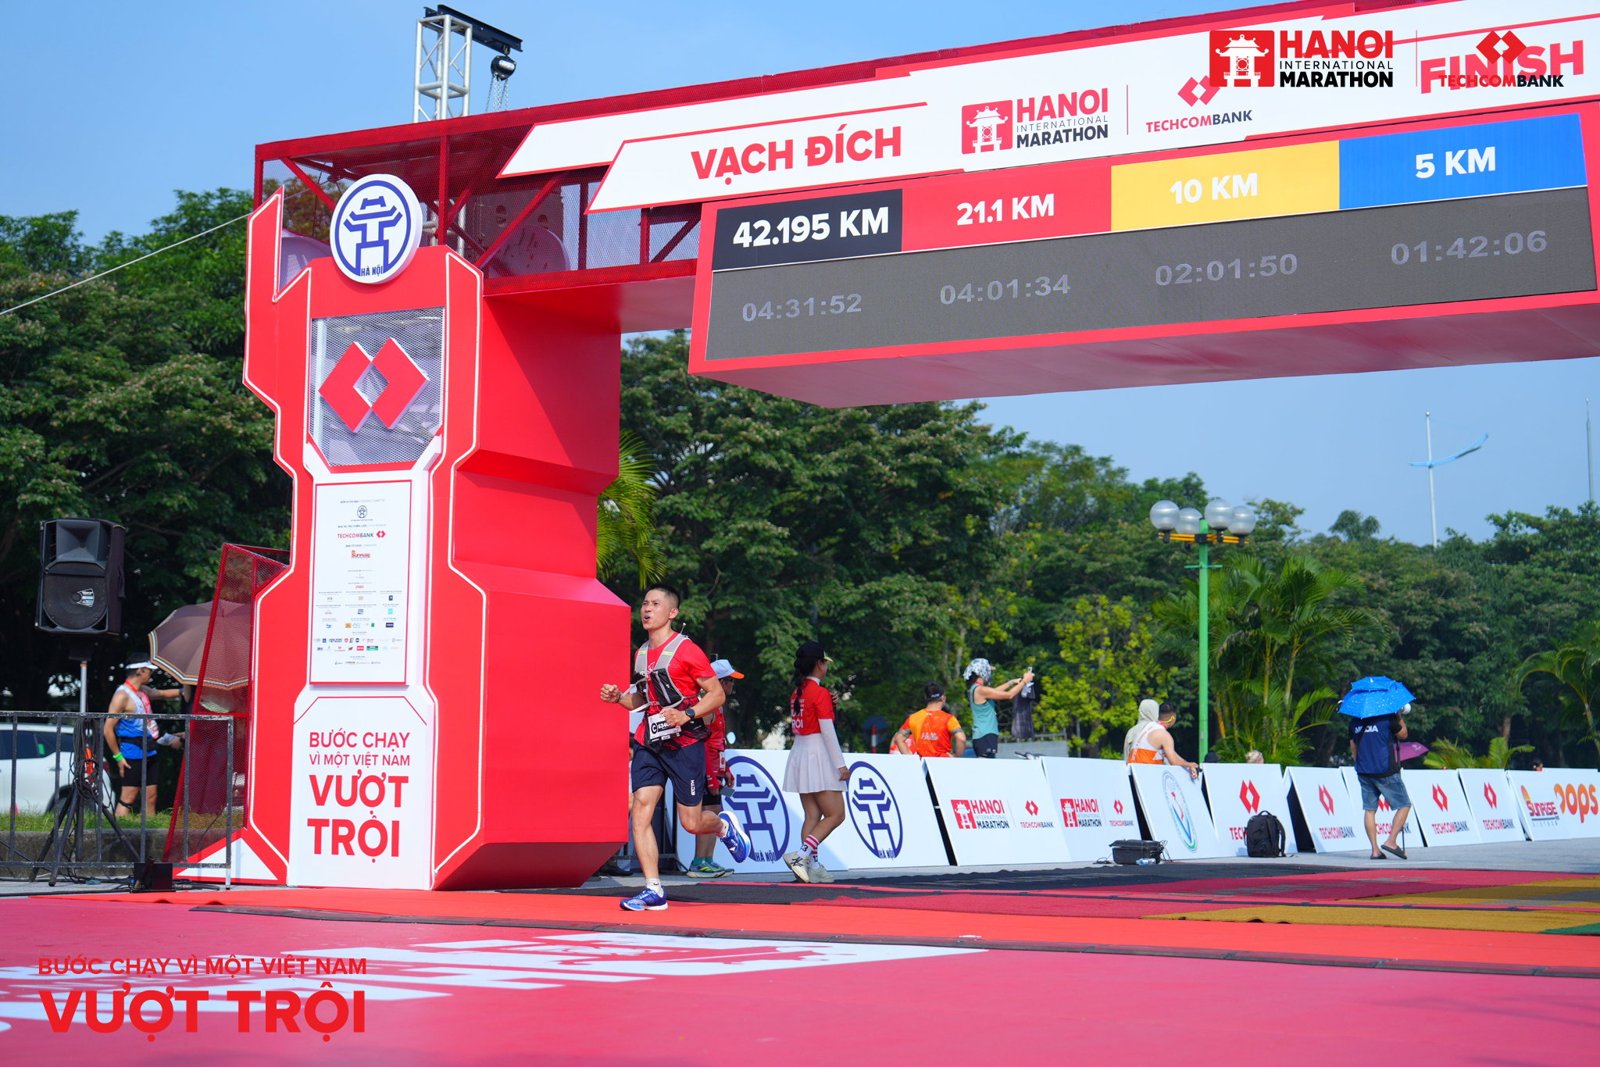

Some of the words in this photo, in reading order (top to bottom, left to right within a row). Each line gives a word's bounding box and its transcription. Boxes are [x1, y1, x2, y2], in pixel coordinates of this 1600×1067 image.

[1421, 40, 1585, 94] FINISH
[1016, 87, 1109, 122] HANOI
[1016, 114, 1109, 133] INTERNATIONAL
[1145, 109, 1253, 134] TECHCOMBANK
[1016, 124, 1109, 149] MARATHON
[690, 137, 794, 185] VẠCH
[804, 123, 901, 167] ĐÍCH
[1414, 153, 1436, 179] 5
[1445, 146, 1496, 176] KM
[1169, 177, 1203, 205] 10
[1210, 172, 1259, 201] KM
[956, 196, 1003, 226] 21.1
[1010, 193, 1055, 221] KM
[732, 211, 831, 249] 42.195
[838, 205, 889, 238] KM
[1390, 230, 1548, 267] 01:42:06
[360, 265, 371, 276] HÀ
[1154, 253, 1298, 287] 02:01:50
[939, 273, 1071, 305] 04:01:34
[741, 293, 863, 323] 04:31:52
[309, 728, 357, 748] BƯỚC
[362, 732, 410, 752] CHẠY
[309, 751, 320, 765] VÌ
[324, 751, 350, 768] MỘT
[353, 752, 379, 768] VIỆT
[382, 754, 410, 766] NAM
[309, 769, 409, 815] VƯỢT
[970, 799, 1005, 814] HANOI
[1074, 799, 1099, 813] HANOI
[976, 820, 1010, 829] MARATHON
[1078, 819, 1102, 827] MARATHON
[1432, 820, 1470, 834] TECHCOMBANK
[1482, 819, 1515, 831] TECHCOMBANK
[307, 815, 400, 863] TRỘI
[754, 850, 765, 862] HÀ
